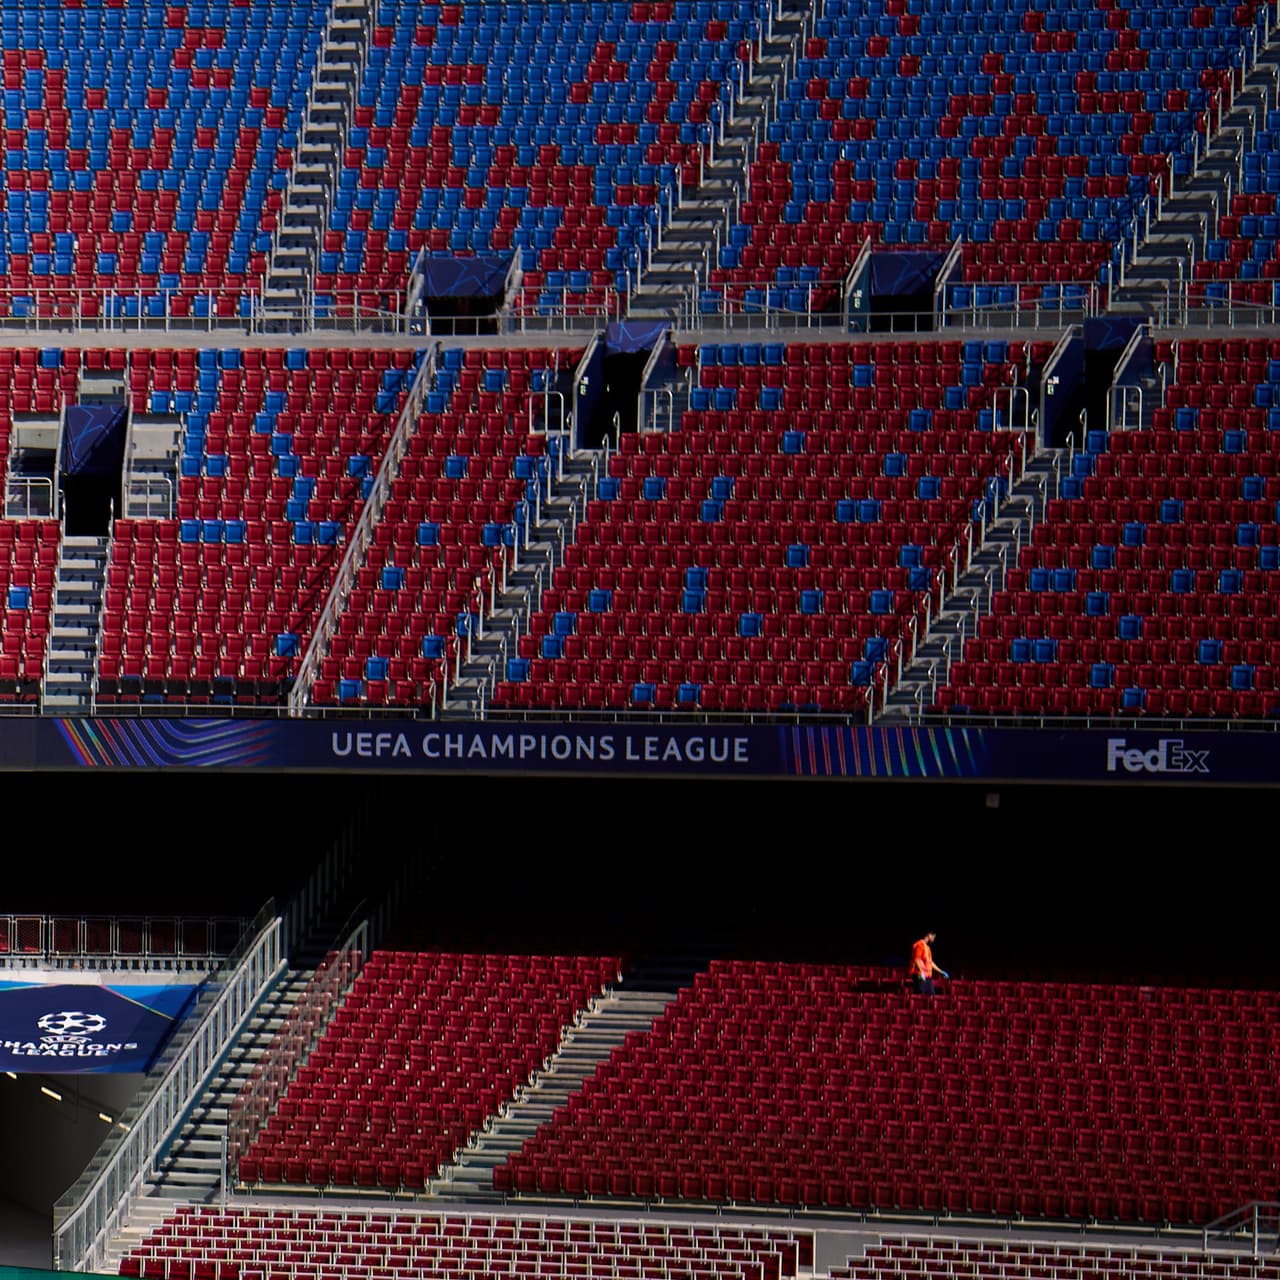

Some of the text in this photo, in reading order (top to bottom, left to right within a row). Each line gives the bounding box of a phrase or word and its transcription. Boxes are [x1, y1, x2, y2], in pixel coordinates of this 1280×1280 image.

[332, 732, 749, 763] UEFA CHAMPIONS LEAGUE
[1107, 739, 1210, 773] FedEx
[12, 1048, 109, 1057] LEAGUE
